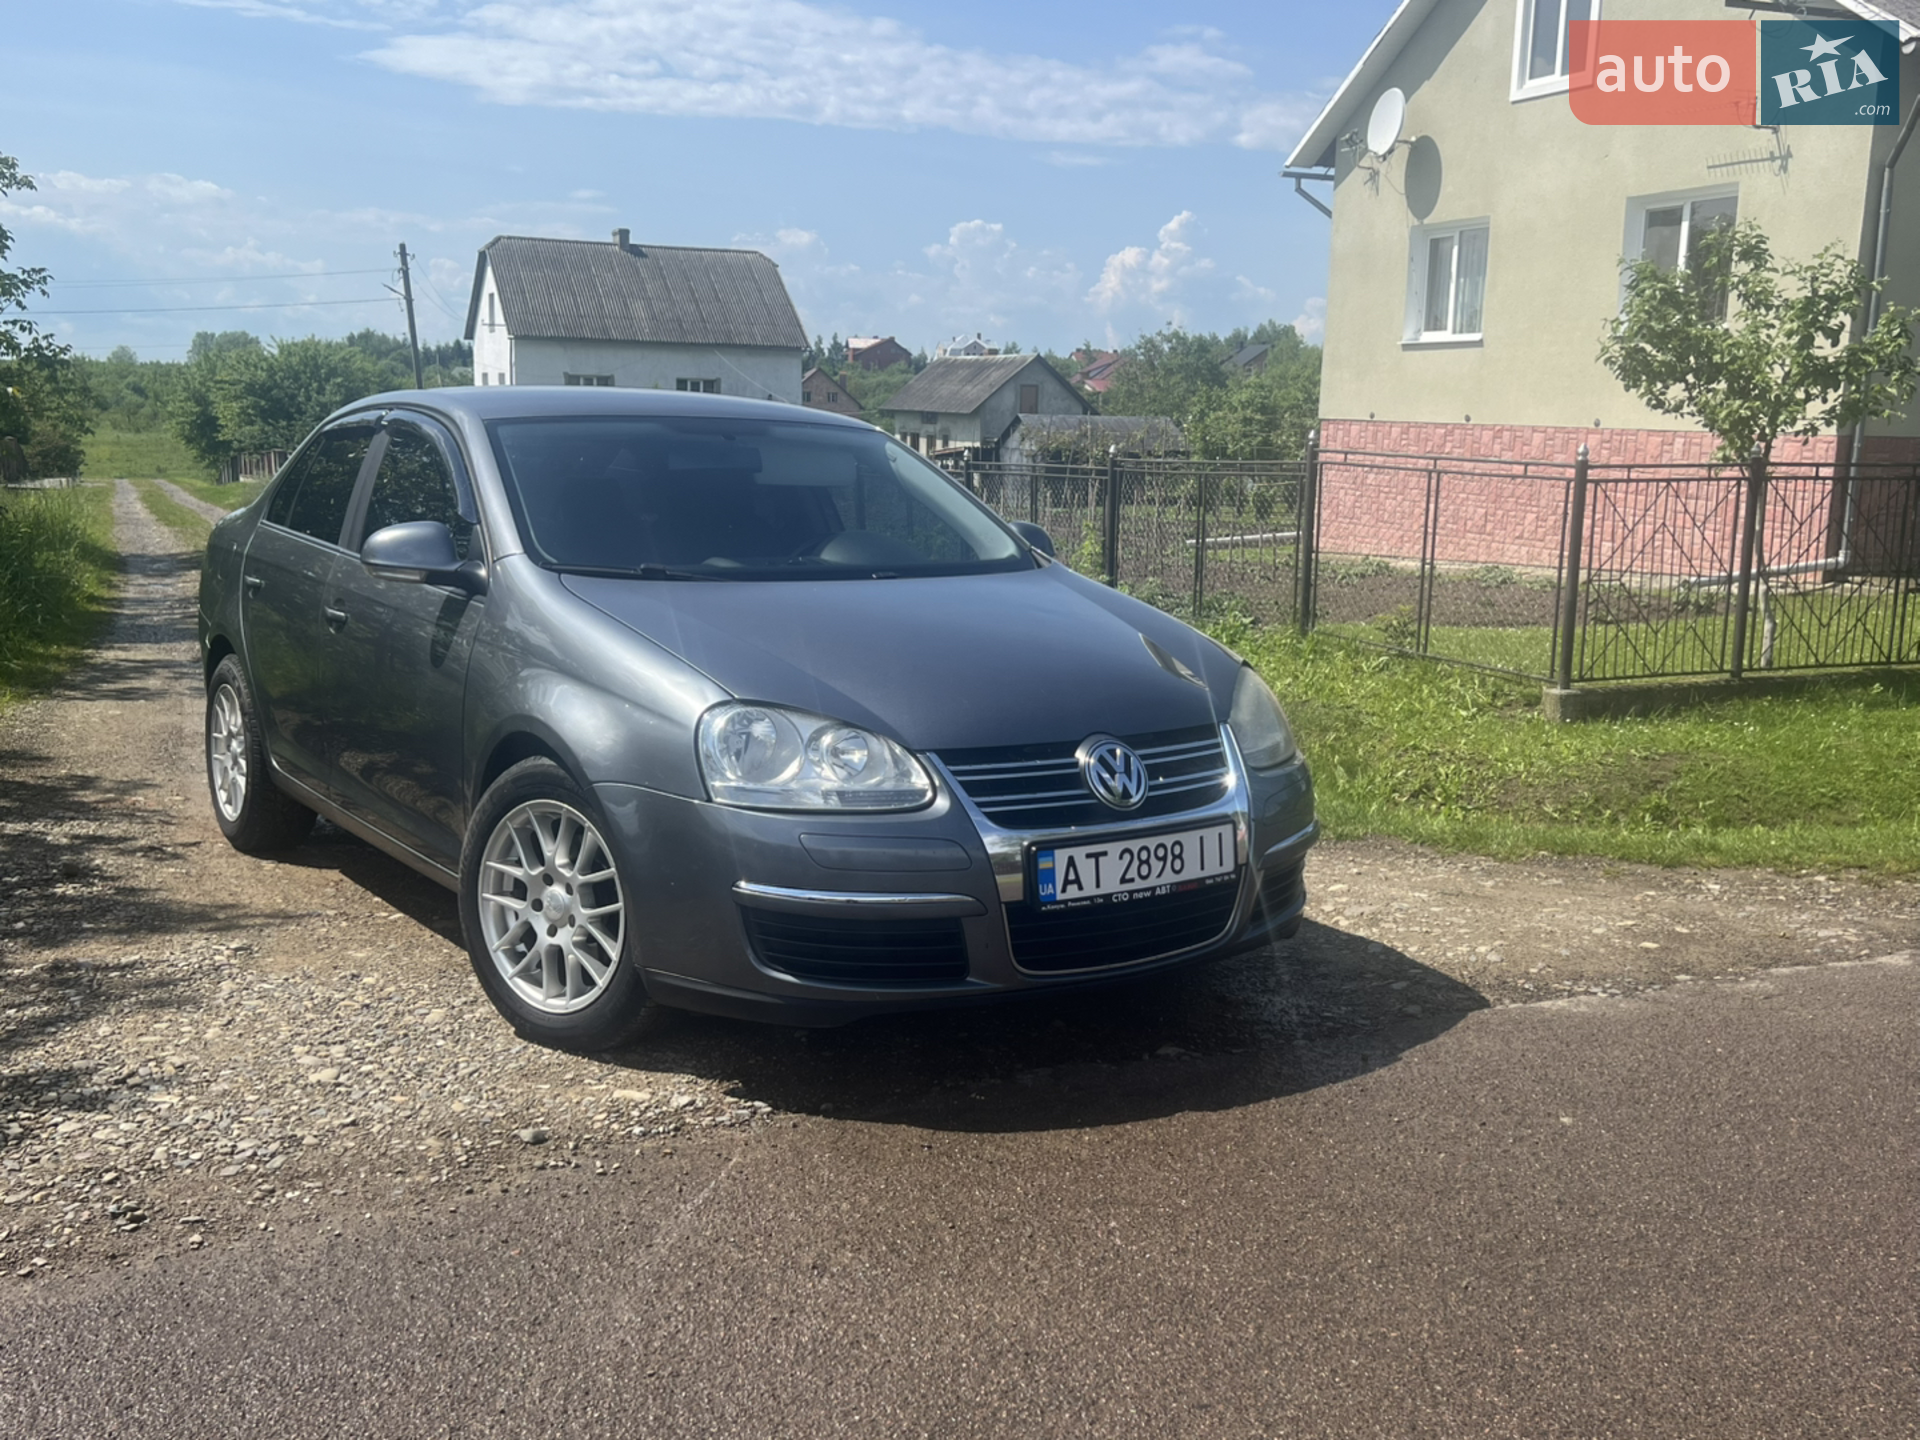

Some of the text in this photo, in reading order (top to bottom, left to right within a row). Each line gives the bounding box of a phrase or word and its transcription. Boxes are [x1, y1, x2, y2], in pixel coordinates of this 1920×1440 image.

[1060, 849, 1108, 894] AT
[1118, 839, 1185, 886] 2898
[1039, 883, 1055, 897] UA
[1132, 889, 1152, 900] new
